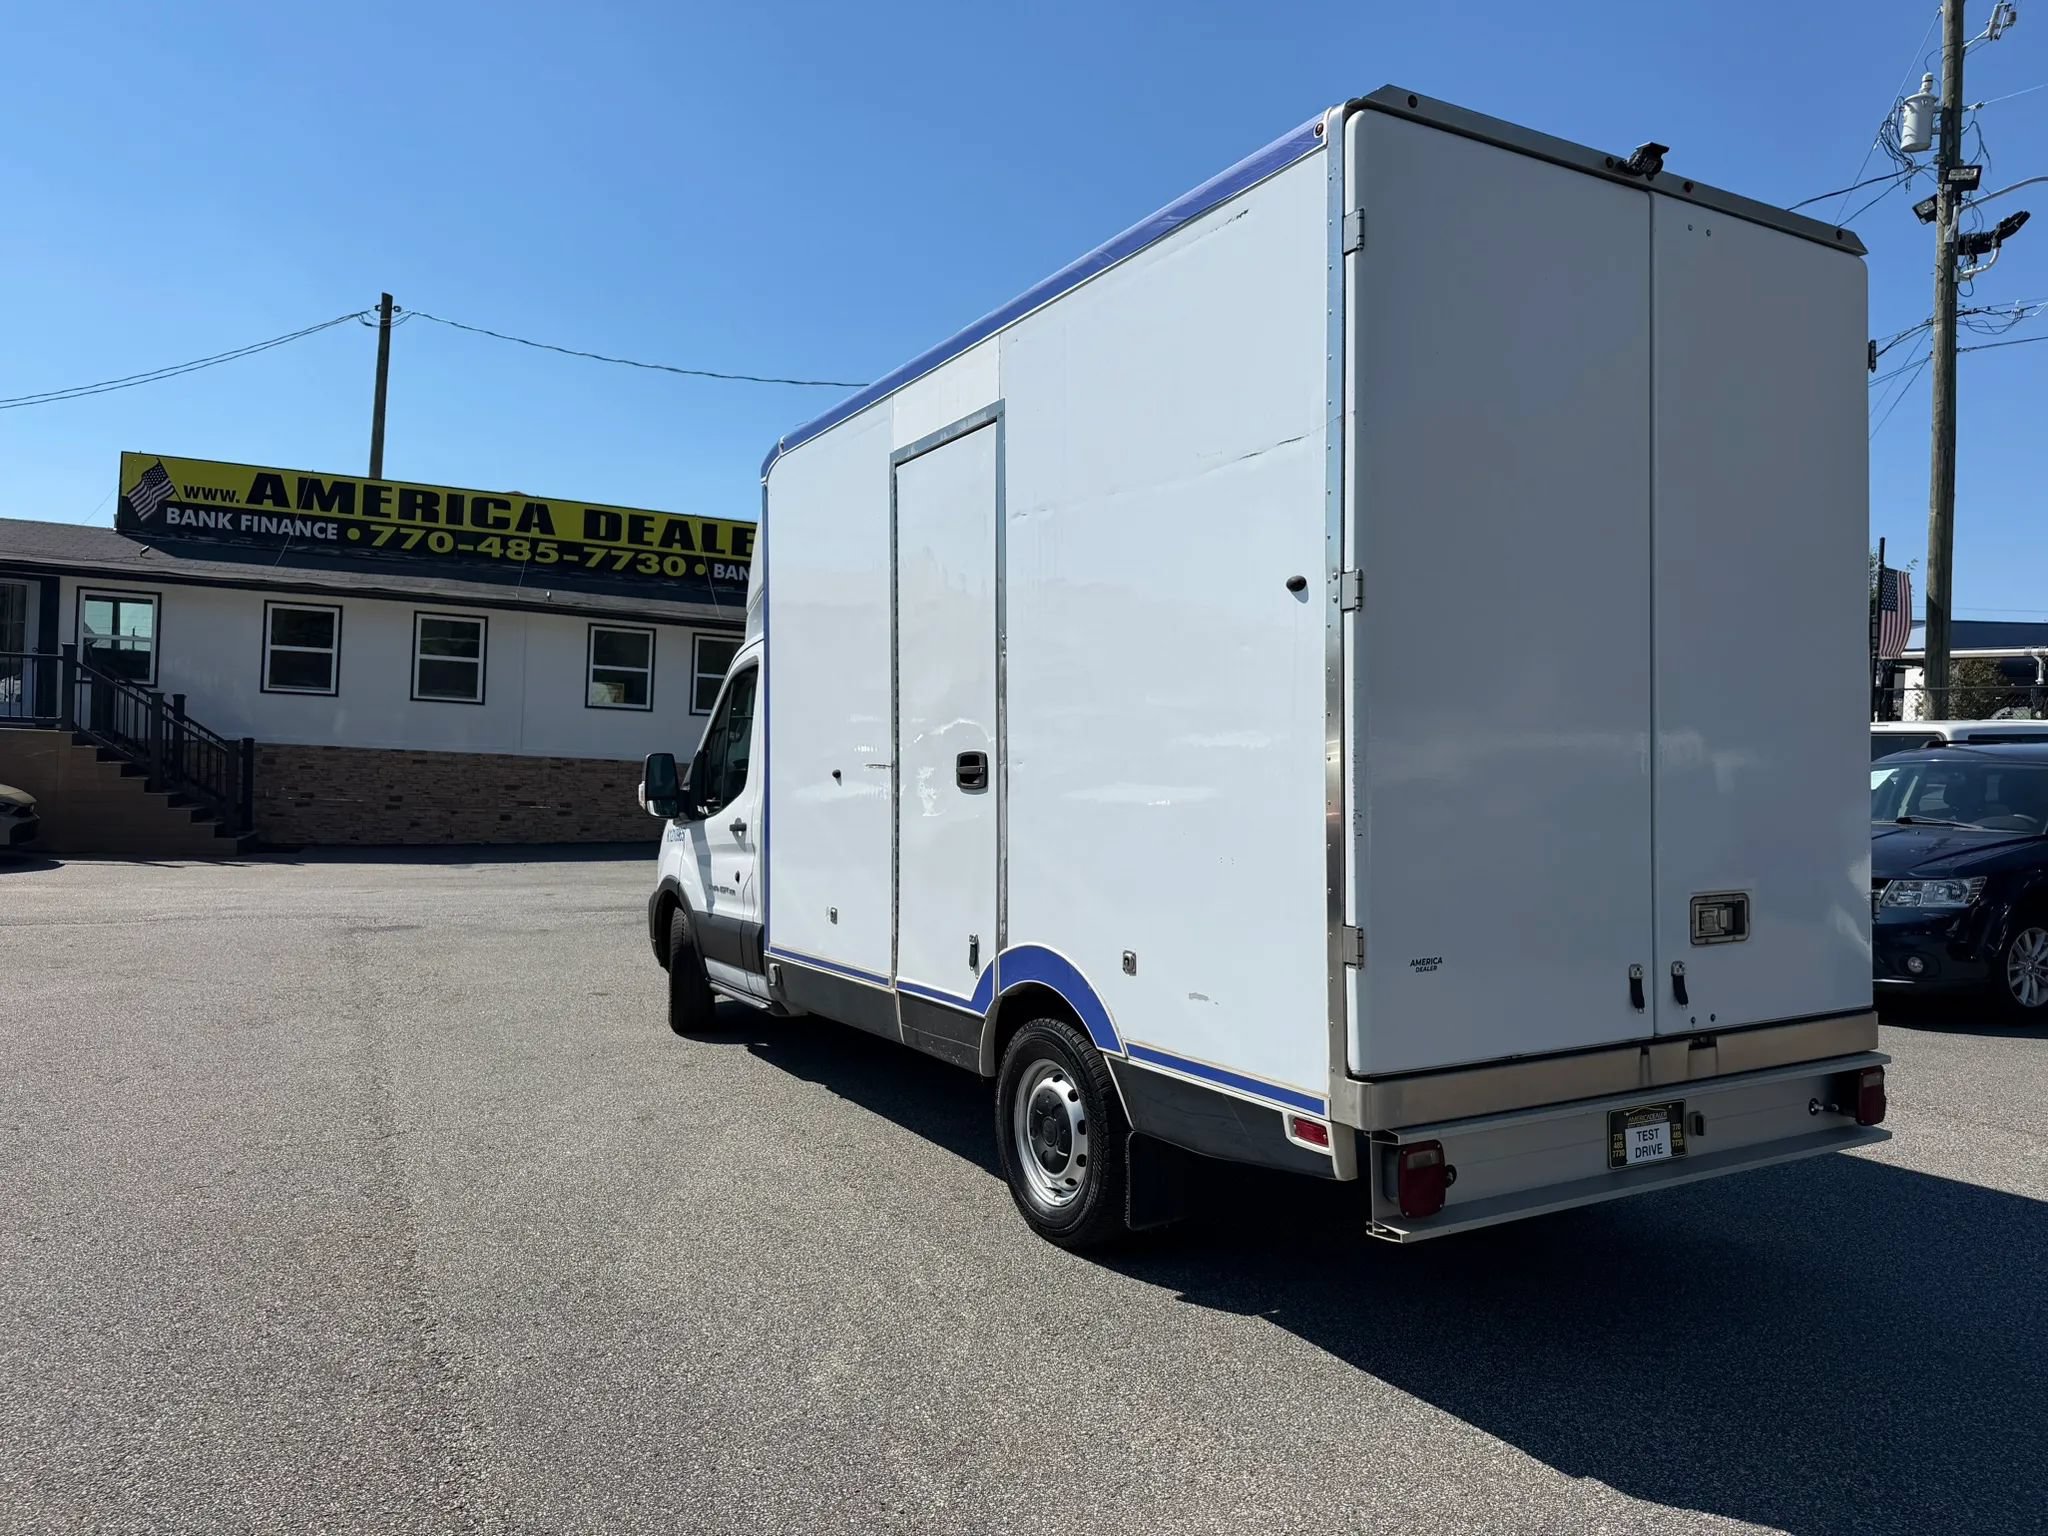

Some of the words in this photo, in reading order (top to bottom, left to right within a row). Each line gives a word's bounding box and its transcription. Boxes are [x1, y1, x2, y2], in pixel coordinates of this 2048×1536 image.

[245, 472, 556, 536] AMERICA
[165, 506, 233, 530] BANK
[239, 515, 338, 541] FINANCE
[368, 525, 687, 577] 770-485-7730
[1410, 957, 1443, 967] AMERICA
[1415, 965, 1438, 973] DEALER
[1636, 1128, 1660, 1142] TEST
[1635, 1143, 1664, 1158] DRIVE
